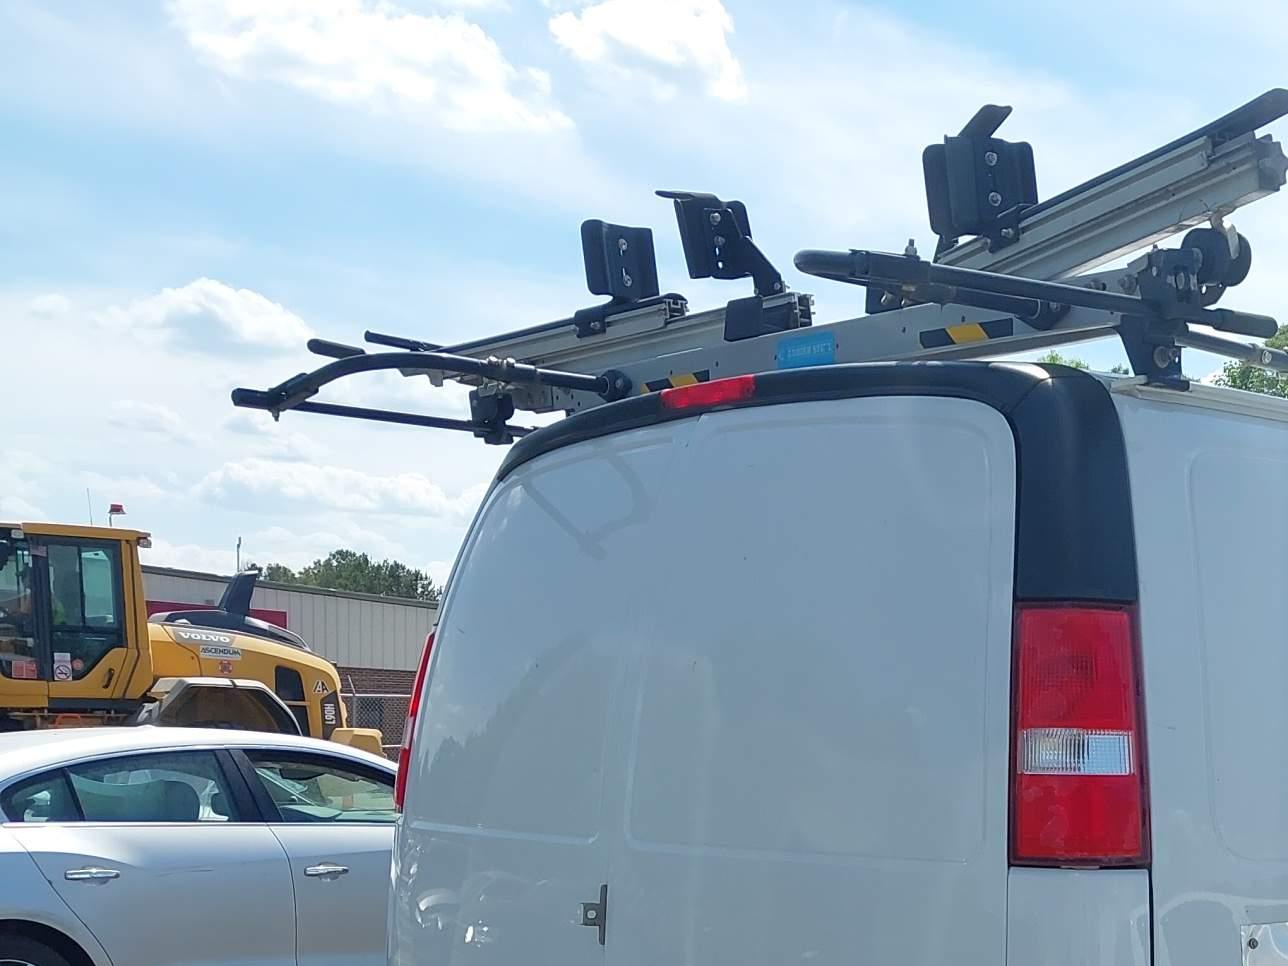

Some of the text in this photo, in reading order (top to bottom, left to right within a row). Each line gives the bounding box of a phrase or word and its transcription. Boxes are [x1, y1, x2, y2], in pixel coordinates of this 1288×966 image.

[178, 631, 230, 643] VOLVO
[200, 647, 241, 657] ASCENDUM
[324, 703, 336, 725] L90H
